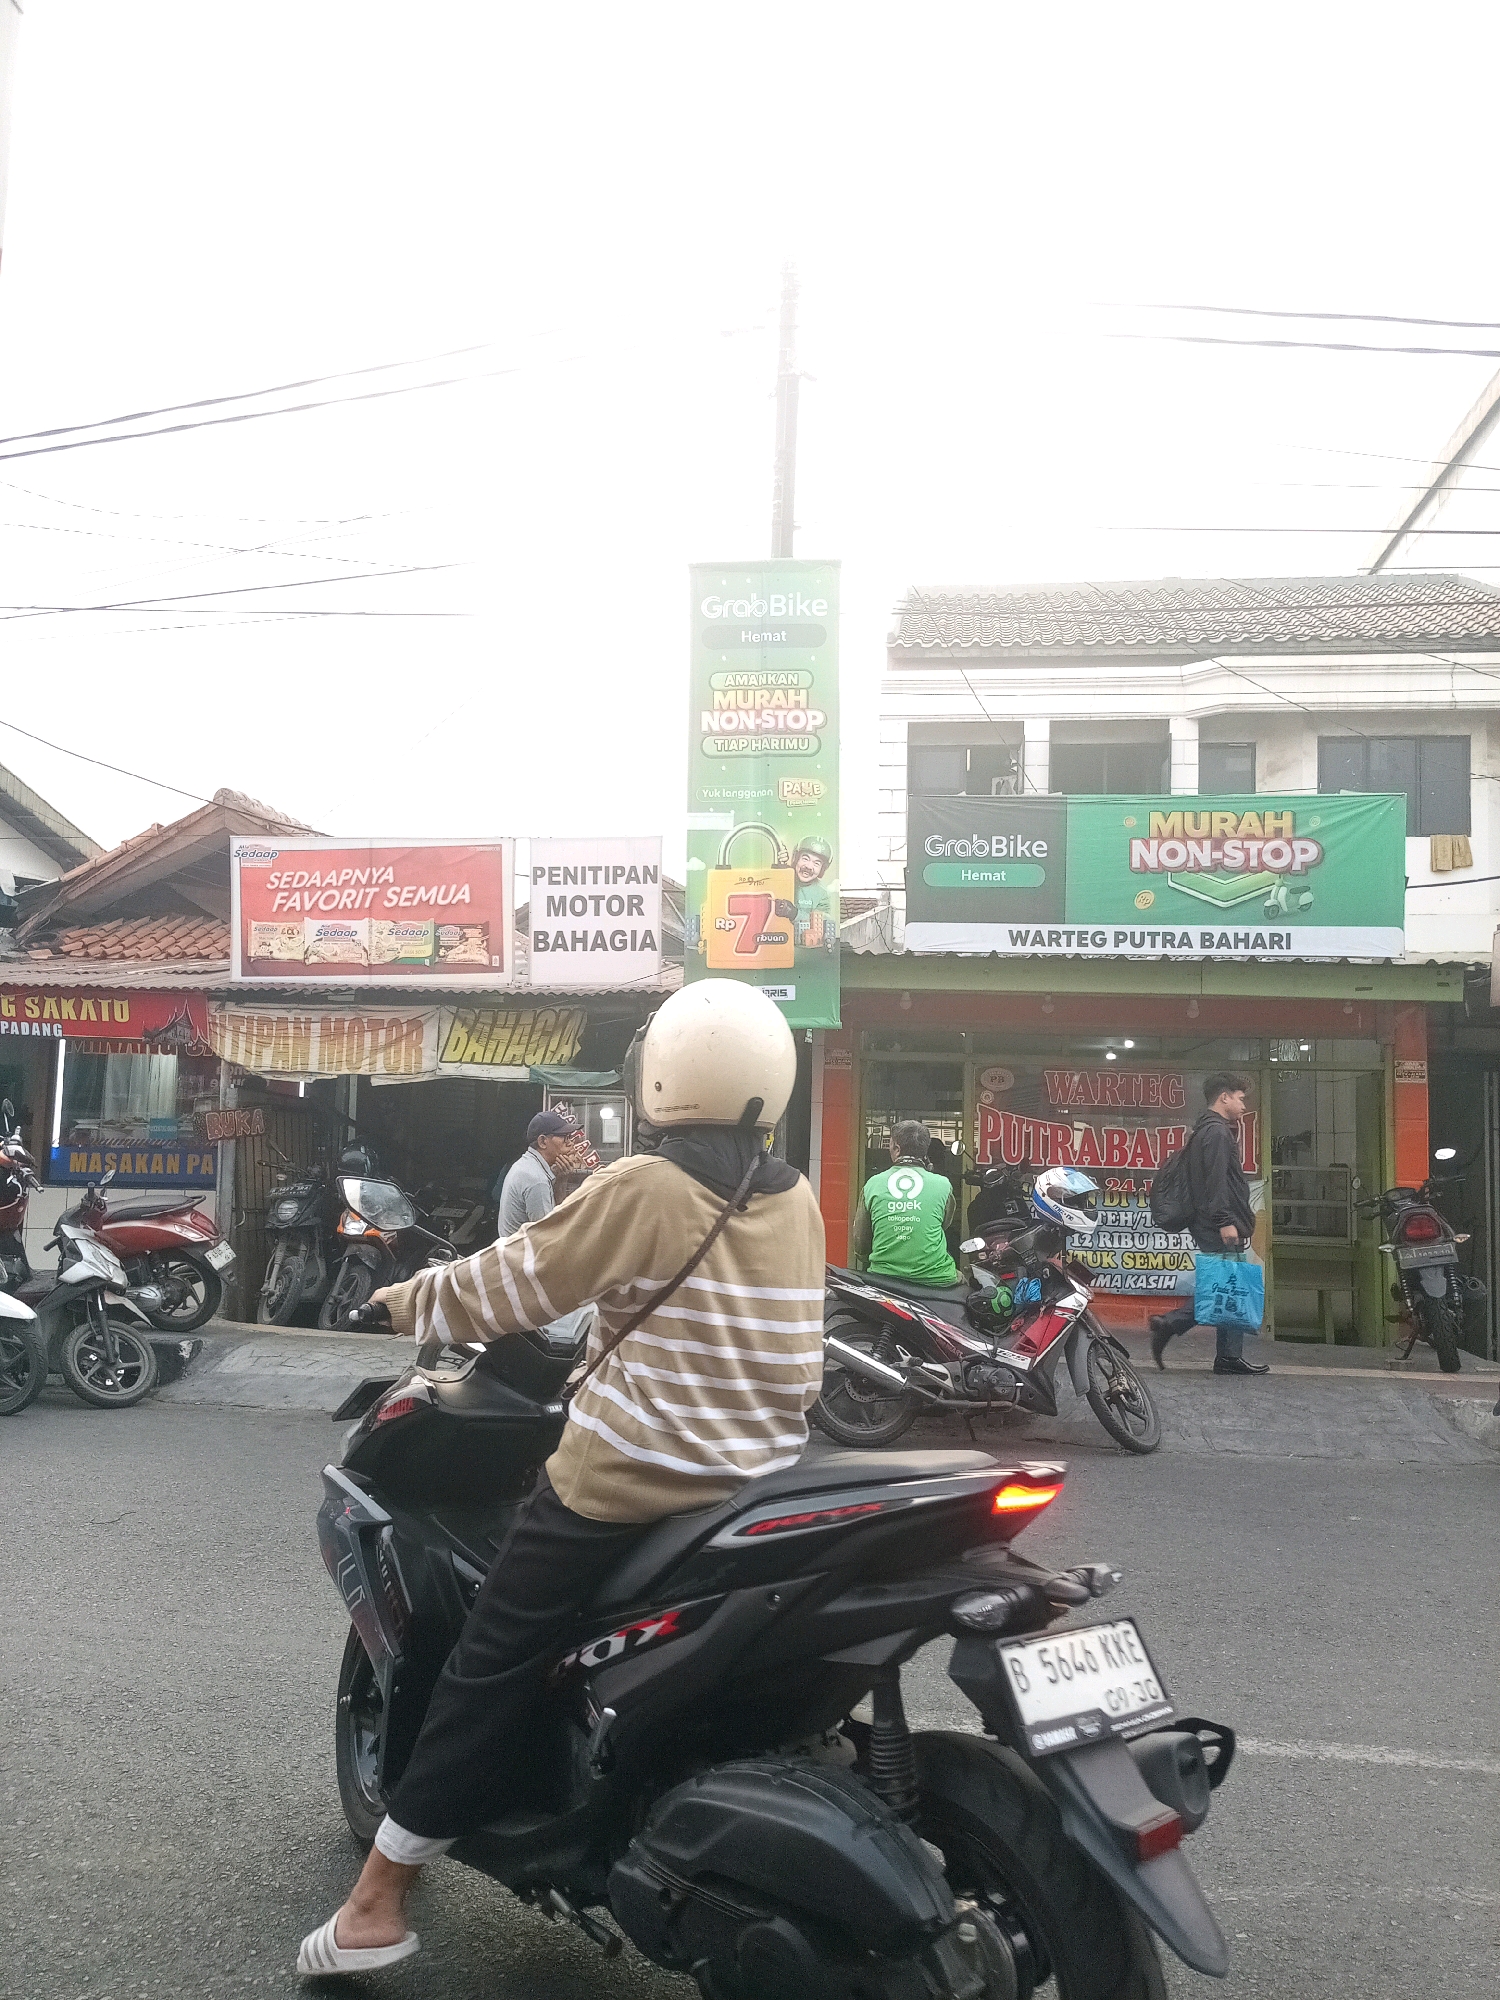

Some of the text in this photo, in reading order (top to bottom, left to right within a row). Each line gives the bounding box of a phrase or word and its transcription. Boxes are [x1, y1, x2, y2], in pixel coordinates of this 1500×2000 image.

[701, 593, 828, 619] GrabBike
[741, 630, 787, 643] Hemat
[724, 672, 799, 687] AMANKAN
[713, 689, 809, 711] MURAH
[700, 709, 826, 733] NON-STOP
[714, 738, 809, 752] TIAP HARIMU
[702, 788, 774, 799] Yuk langganan
[1150, 811, 1293, 838] MURAH
[233, 849, 279, 859] Sedaap
[924, 834, 1048, 858] GrabBike
[1131, 839, 1320, 871] NON-STOP
[265, 866, 394, 889] SEDAAPNYA
[532, 865, 658, 885] PENITIPAN
[961, 869, 1007, 881] Hemat
[271, 883, 471, 913] FAVORIT SEMUA
[546, 895, 645, 917] MOTOR
[315, 928, 358, 938] Sedaap
[387, 927, 430, 937] Sedaap
[715, 917, 736, 932] Rp
[728, 894, 773, 955] 7
[533, 930, 658, 952] BAHAGIA
[756, 933, 785, 943] ribuan
[1008, 930, 1292, 951] WARTEG PUTRA BAHARI
[0, 1020, 63, 1037] PADANG
[440, 1007, 586, 1067] BAHAGIA
[319, 1016, 424, 1076] MOTOR
[1044, 1070, 1185, 1109] WARTEG
[69, 1152, 180, 1174] MASAKAN
[887, 1200, 922, 1213] gojek
[1071, 1233, 1093, 1249] 12
[1097, 1231, 1149, 1249] RIBU
[1121, 1251, 1196, 1270] SEMUA
[1124, 1274, 1177, 1290] KASIH
[1010, 1657, 1031, 1694] B
